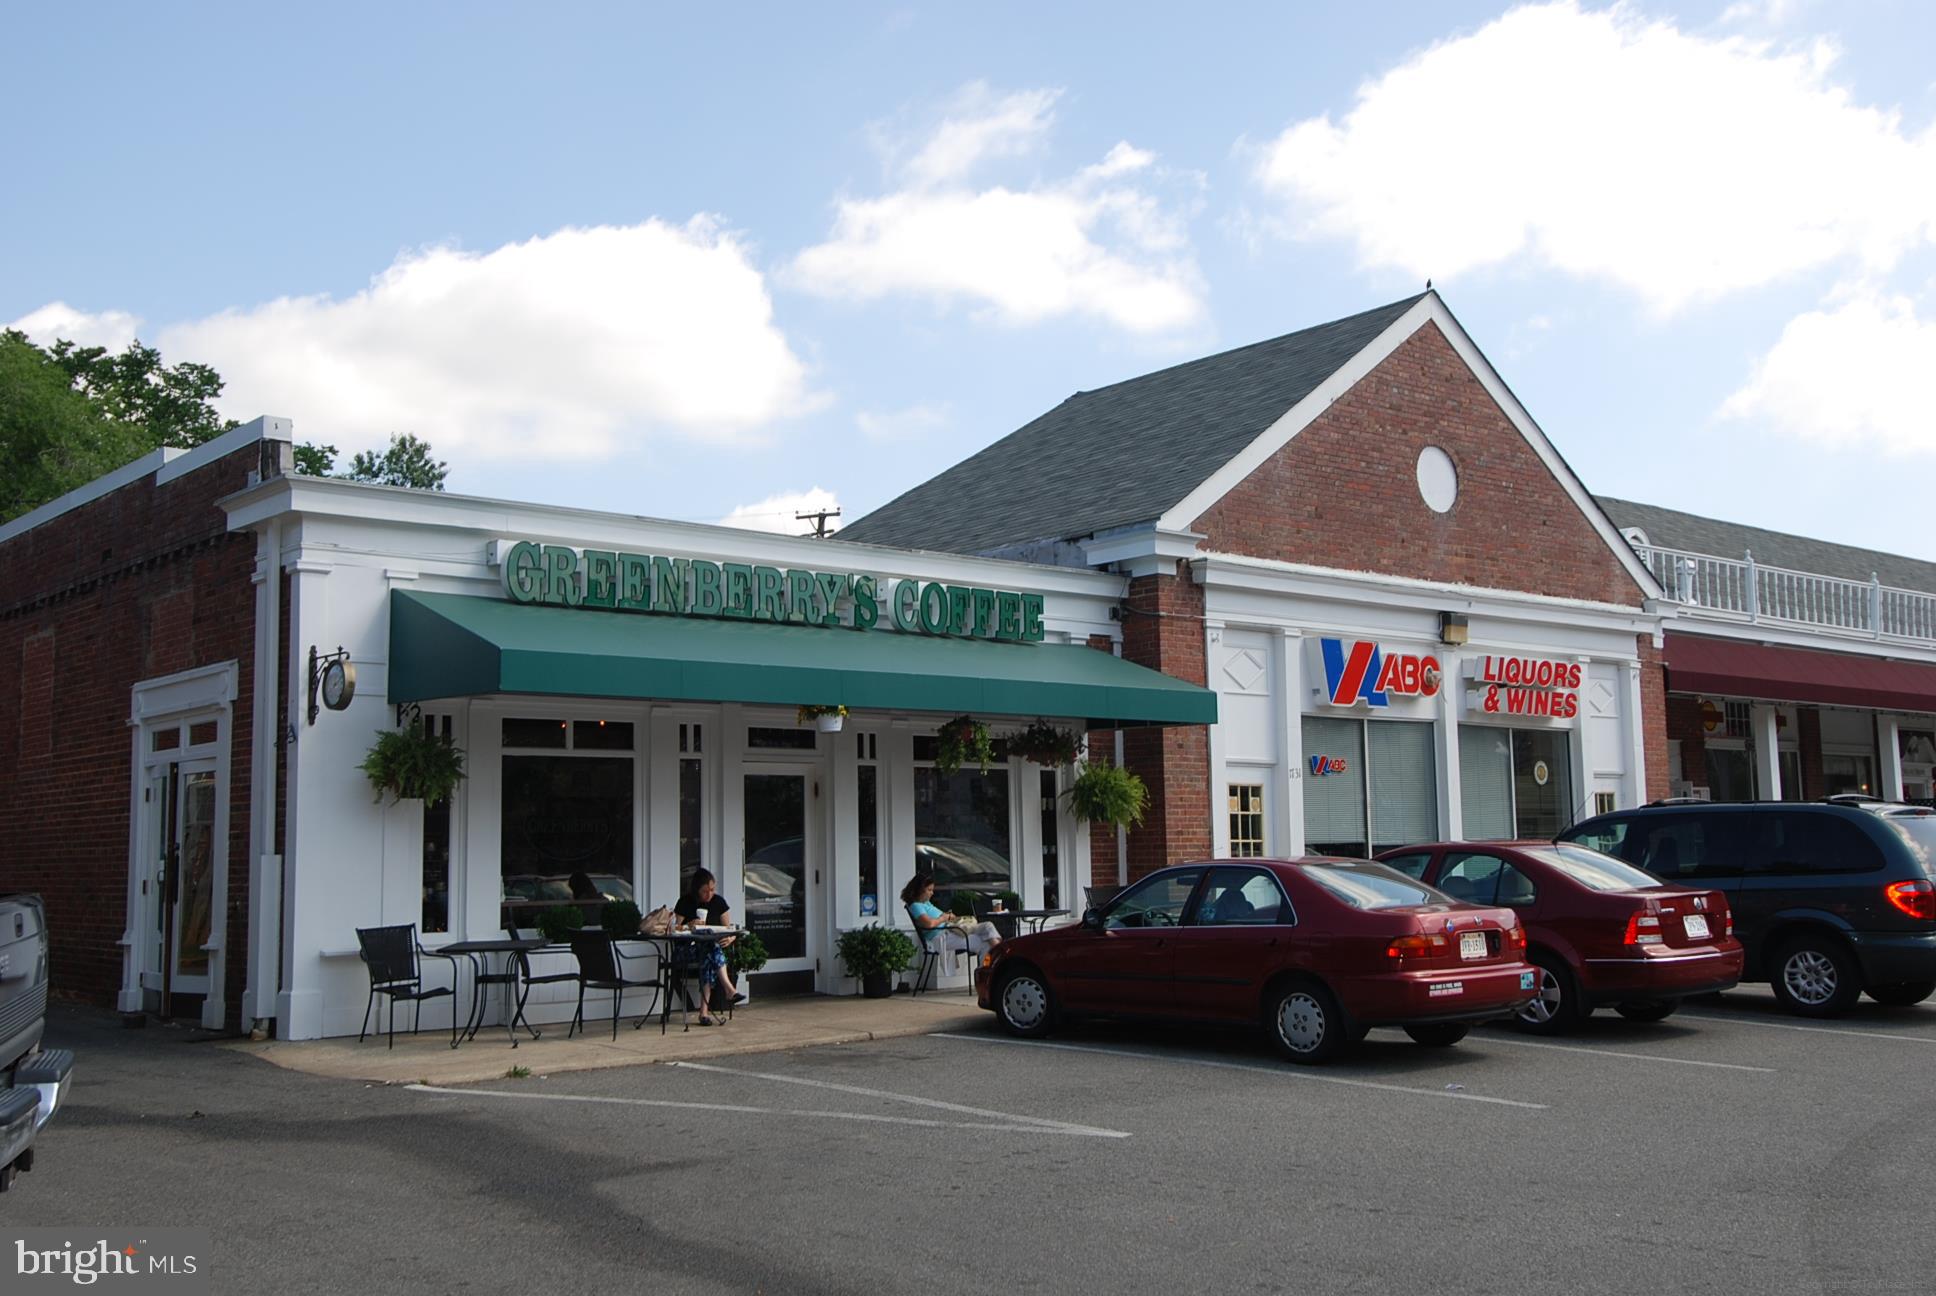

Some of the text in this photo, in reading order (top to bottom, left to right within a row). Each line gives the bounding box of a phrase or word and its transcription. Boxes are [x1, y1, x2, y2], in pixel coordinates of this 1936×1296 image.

[506, 540, 1044, 642] GREENBERRY'S COFFEE
[1374, 653, 1441, 696] ABC
[1483, 655, 1582, 689] LIQUORS
[1483, 684, 1578, 718] & WINES
